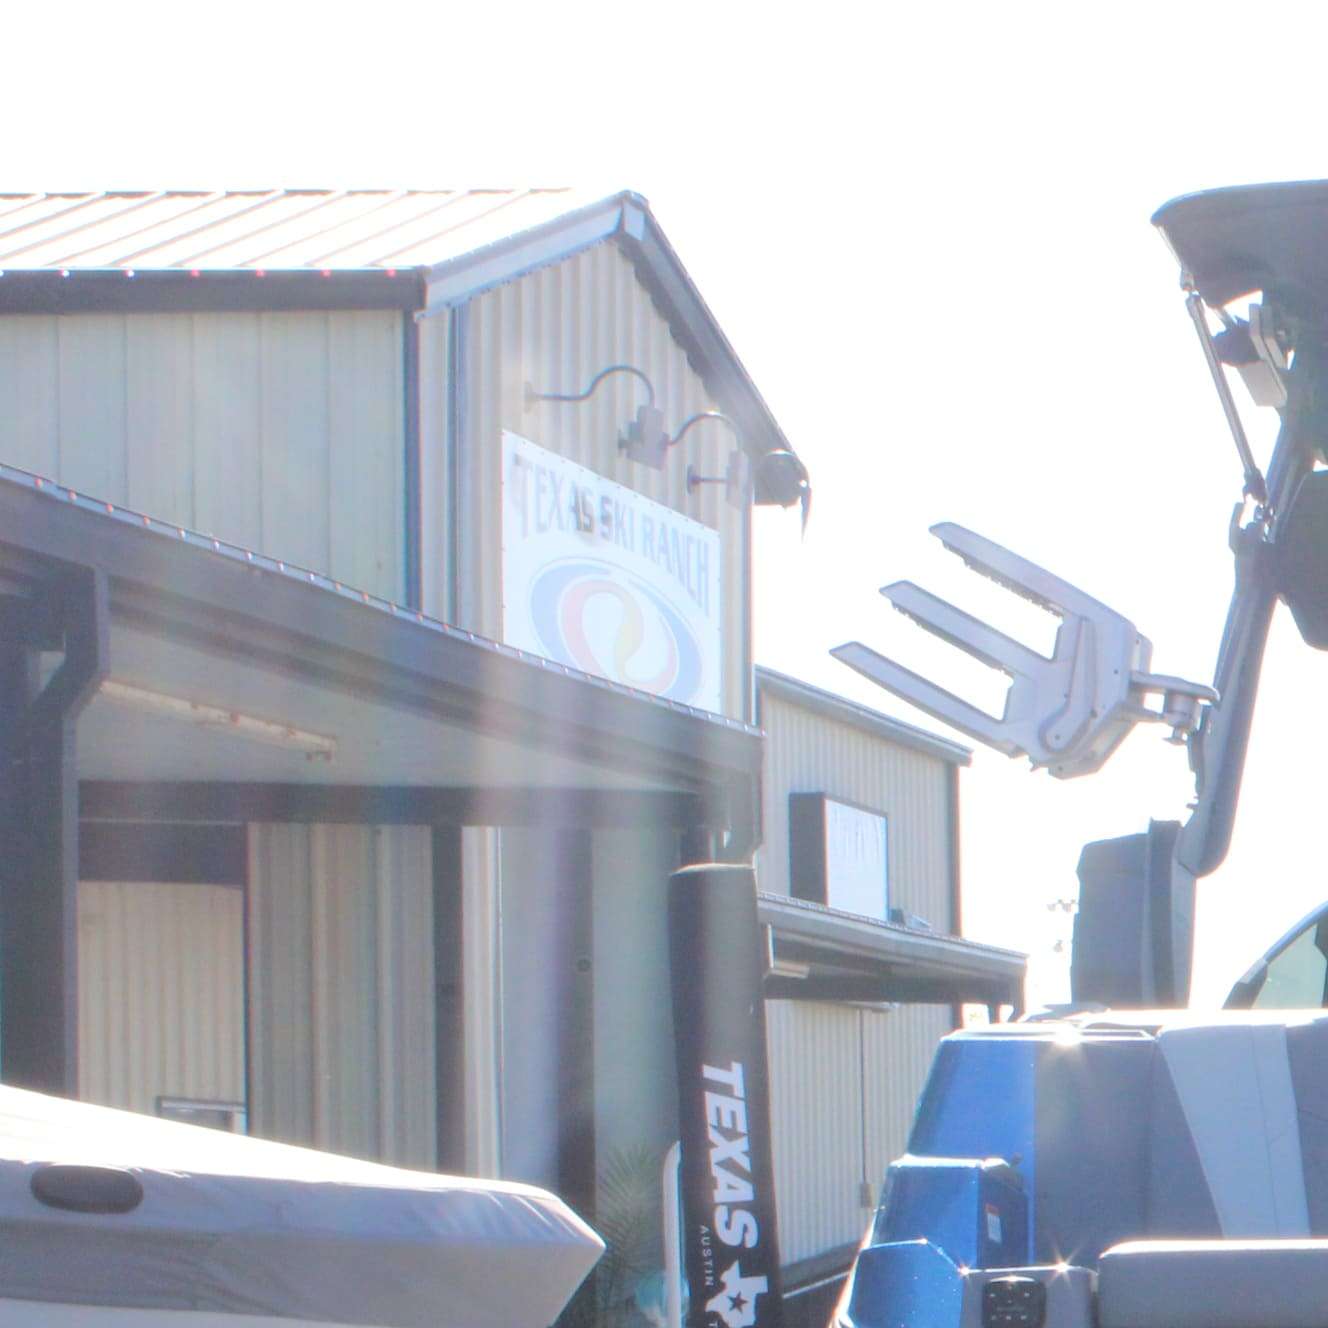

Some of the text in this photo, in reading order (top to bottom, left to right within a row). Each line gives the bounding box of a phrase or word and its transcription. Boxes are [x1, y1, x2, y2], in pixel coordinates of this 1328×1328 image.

[510, 451, 710, 618] TEXAS SKI RANCH
[701, 1060, 760, 1250] TEXAS
[700, 1224, 715, 1287] AUSTIN
